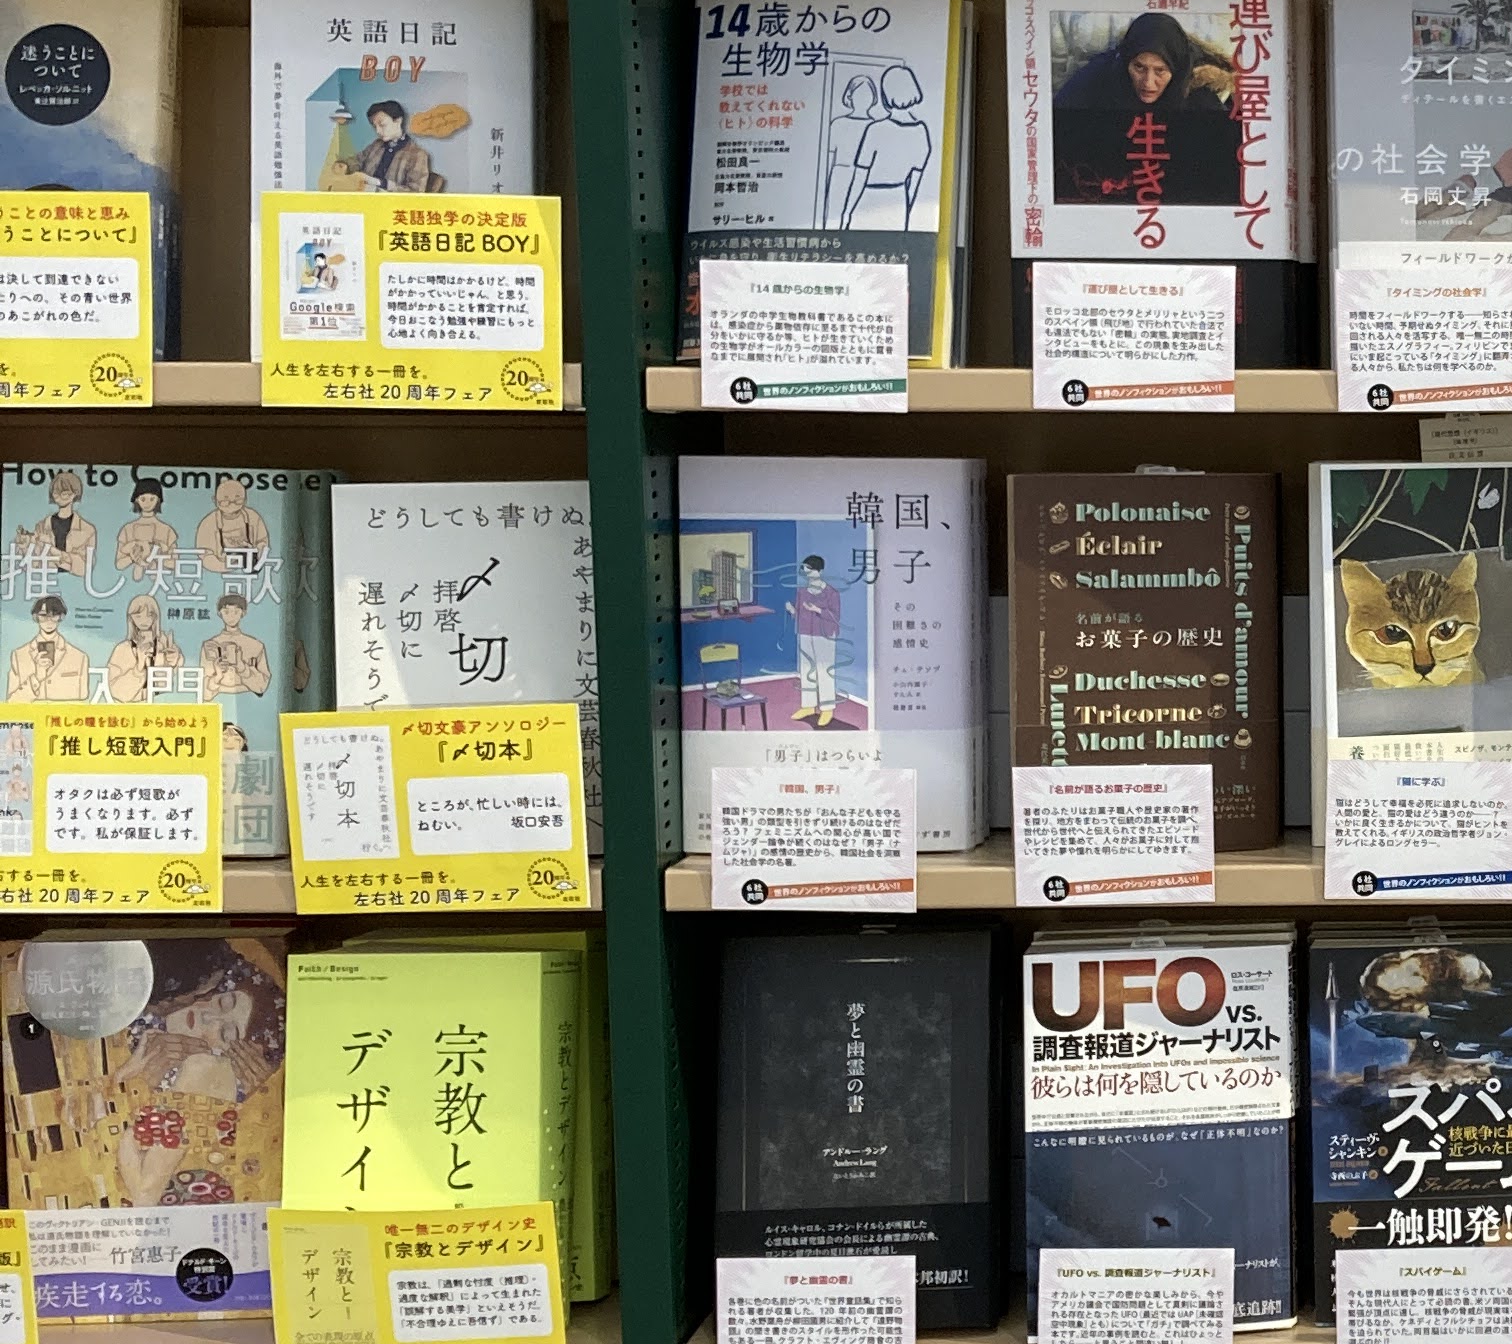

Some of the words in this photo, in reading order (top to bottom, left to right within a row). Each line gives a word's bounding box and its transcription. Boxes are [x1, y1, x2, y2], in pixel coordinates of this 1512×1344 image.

[705, 1, 891, 39] 14歳からの
[326, 19, 458, 47] 英語日記
[359, 55, 427, 83] BOY
[722, 41, 830, 78] 生物学
[1126, 113, 1170, 251] 生きる
[1400, 186, 1493, 206] 石岡丈昇
[392, 210, 528, 228] 英語独学の決定版
[271, 362, 429, 380] 人生を左右する一冊を。
[1075, 502, 1212, 524] Polonaise
[1075, 532, 1164, 557] Éclair
[2, 544, 283, 602] 推し短歌
[847, 548, 931, 585] 男子
[1075, 567, 1222, 590] Salammbô
[1075, 627, 1224, 649] お菓子の歴史
[1074, 670, 1208, 692] Duchesse
[1074, 703, 1203, 725] Tricorne
[47, 735, 208, 759] 『推し短歌入門』
[416, 796, 565, 813] ところが、忙しい時には、
[1031, 956, 1226, 1034] UFO
[1032, 1026, 1280, 1063] 調査報道ジャーナリスト
[845, 1002, 866, 1114] 夢と幽霊の書
[1030, 1067, 1282, 1100] 彼らは何を隠しているのか
[433, 1024, 488, 1190] 宗教と
[384, 1218, 536, 1237] 唯一無二のデザイン史
[382, 1236, 546, 1261] 『宗教とデザイン』
